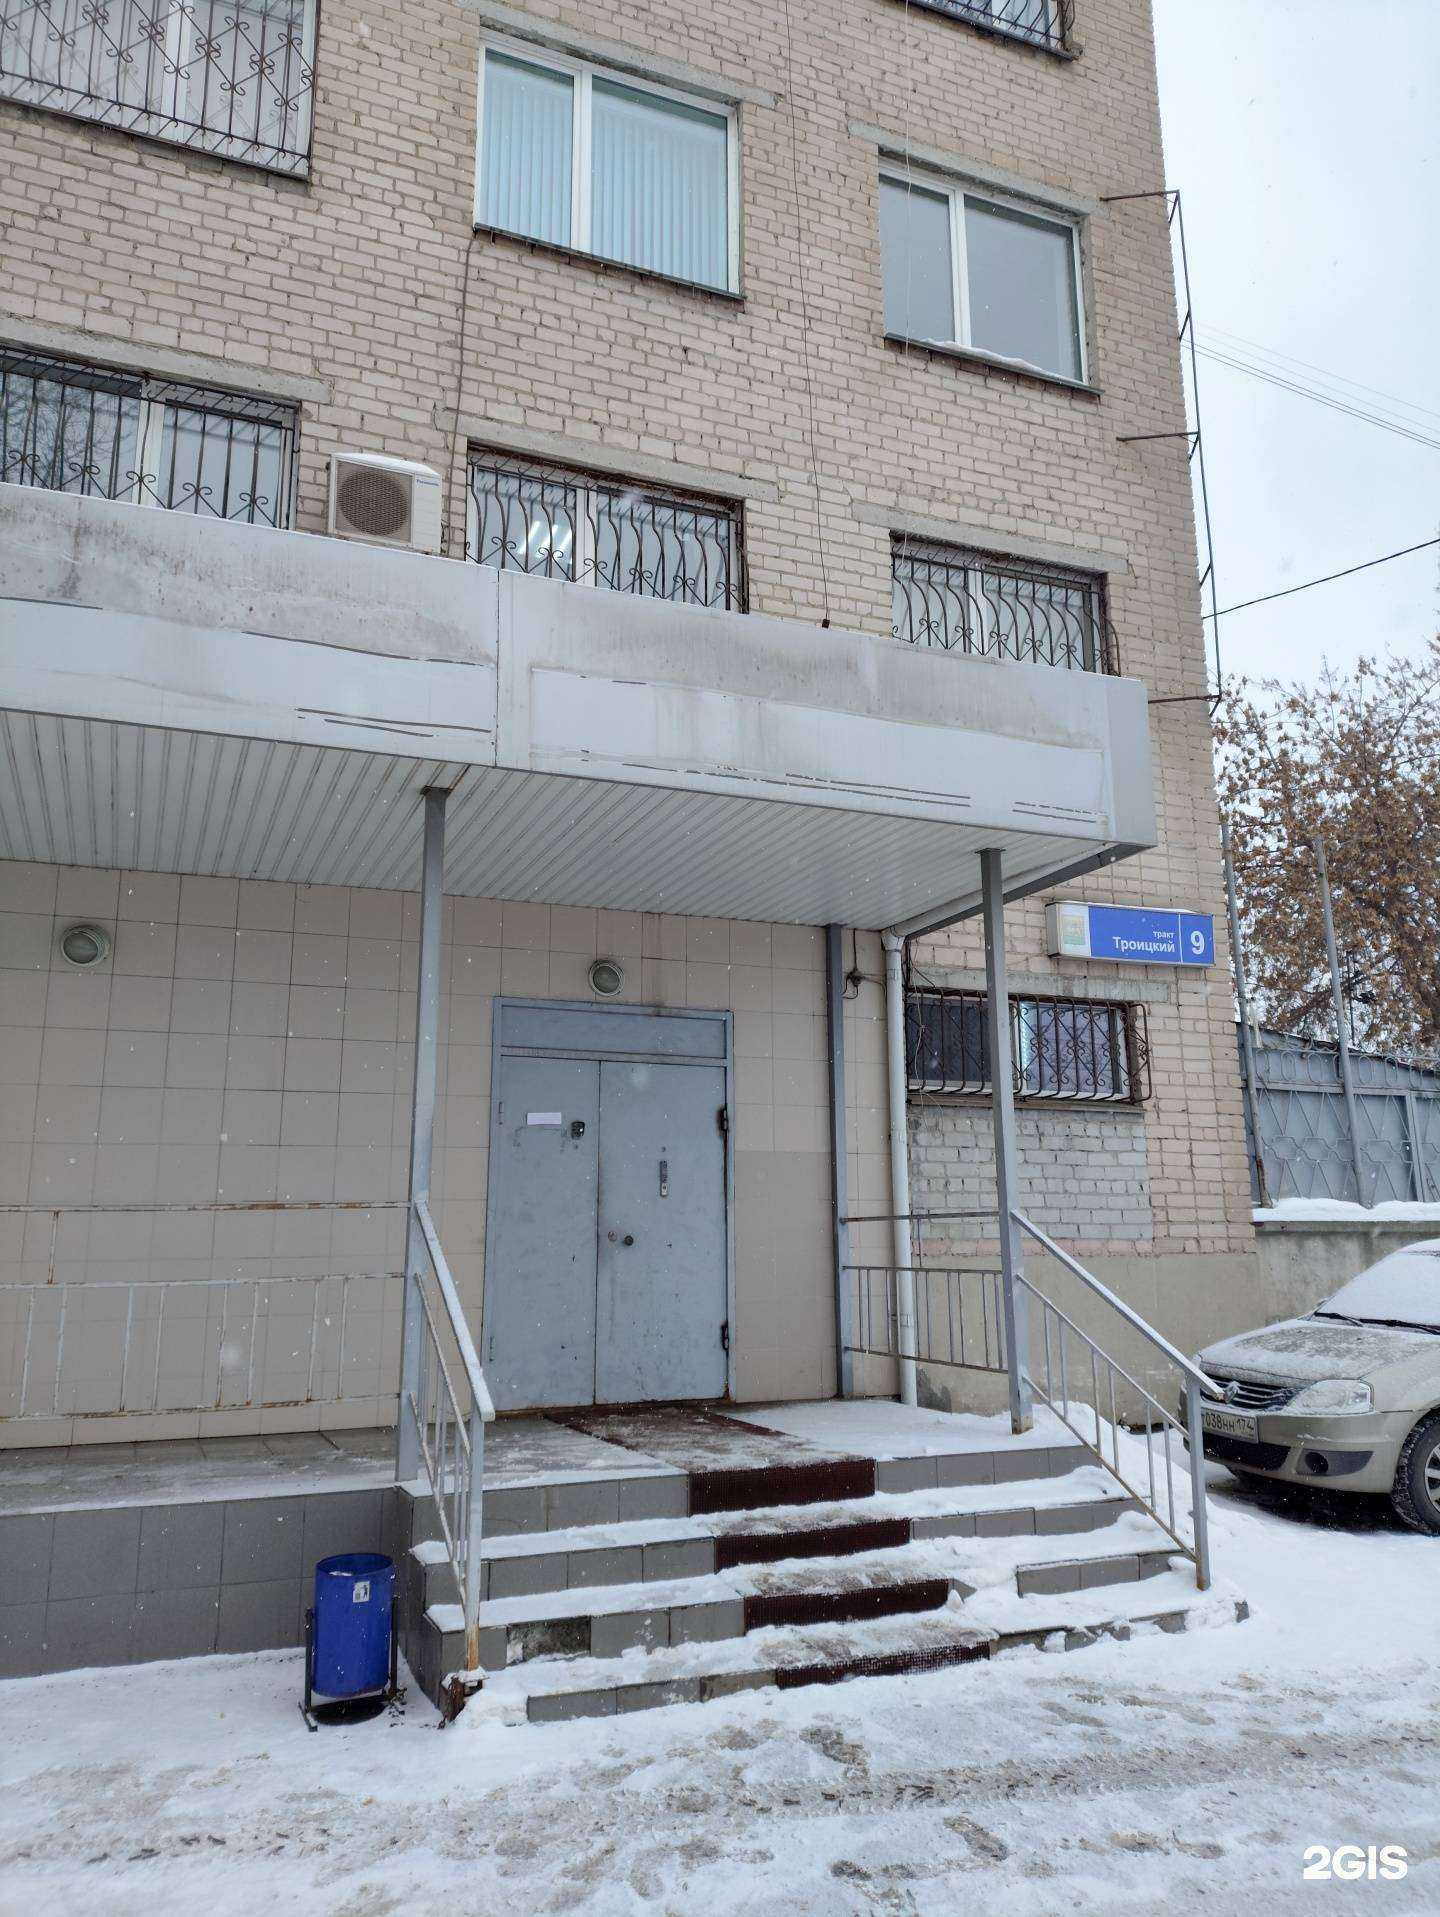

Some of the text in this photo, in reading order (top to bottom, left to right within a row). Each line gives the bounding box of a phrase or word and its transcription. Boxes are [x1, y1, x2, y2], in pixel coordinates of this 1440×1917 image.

[1153, 931, 1175, 939] тракт
[1190, 930, 1205, 955] 9
[1113, 936, 1175, 953] Троицкий
